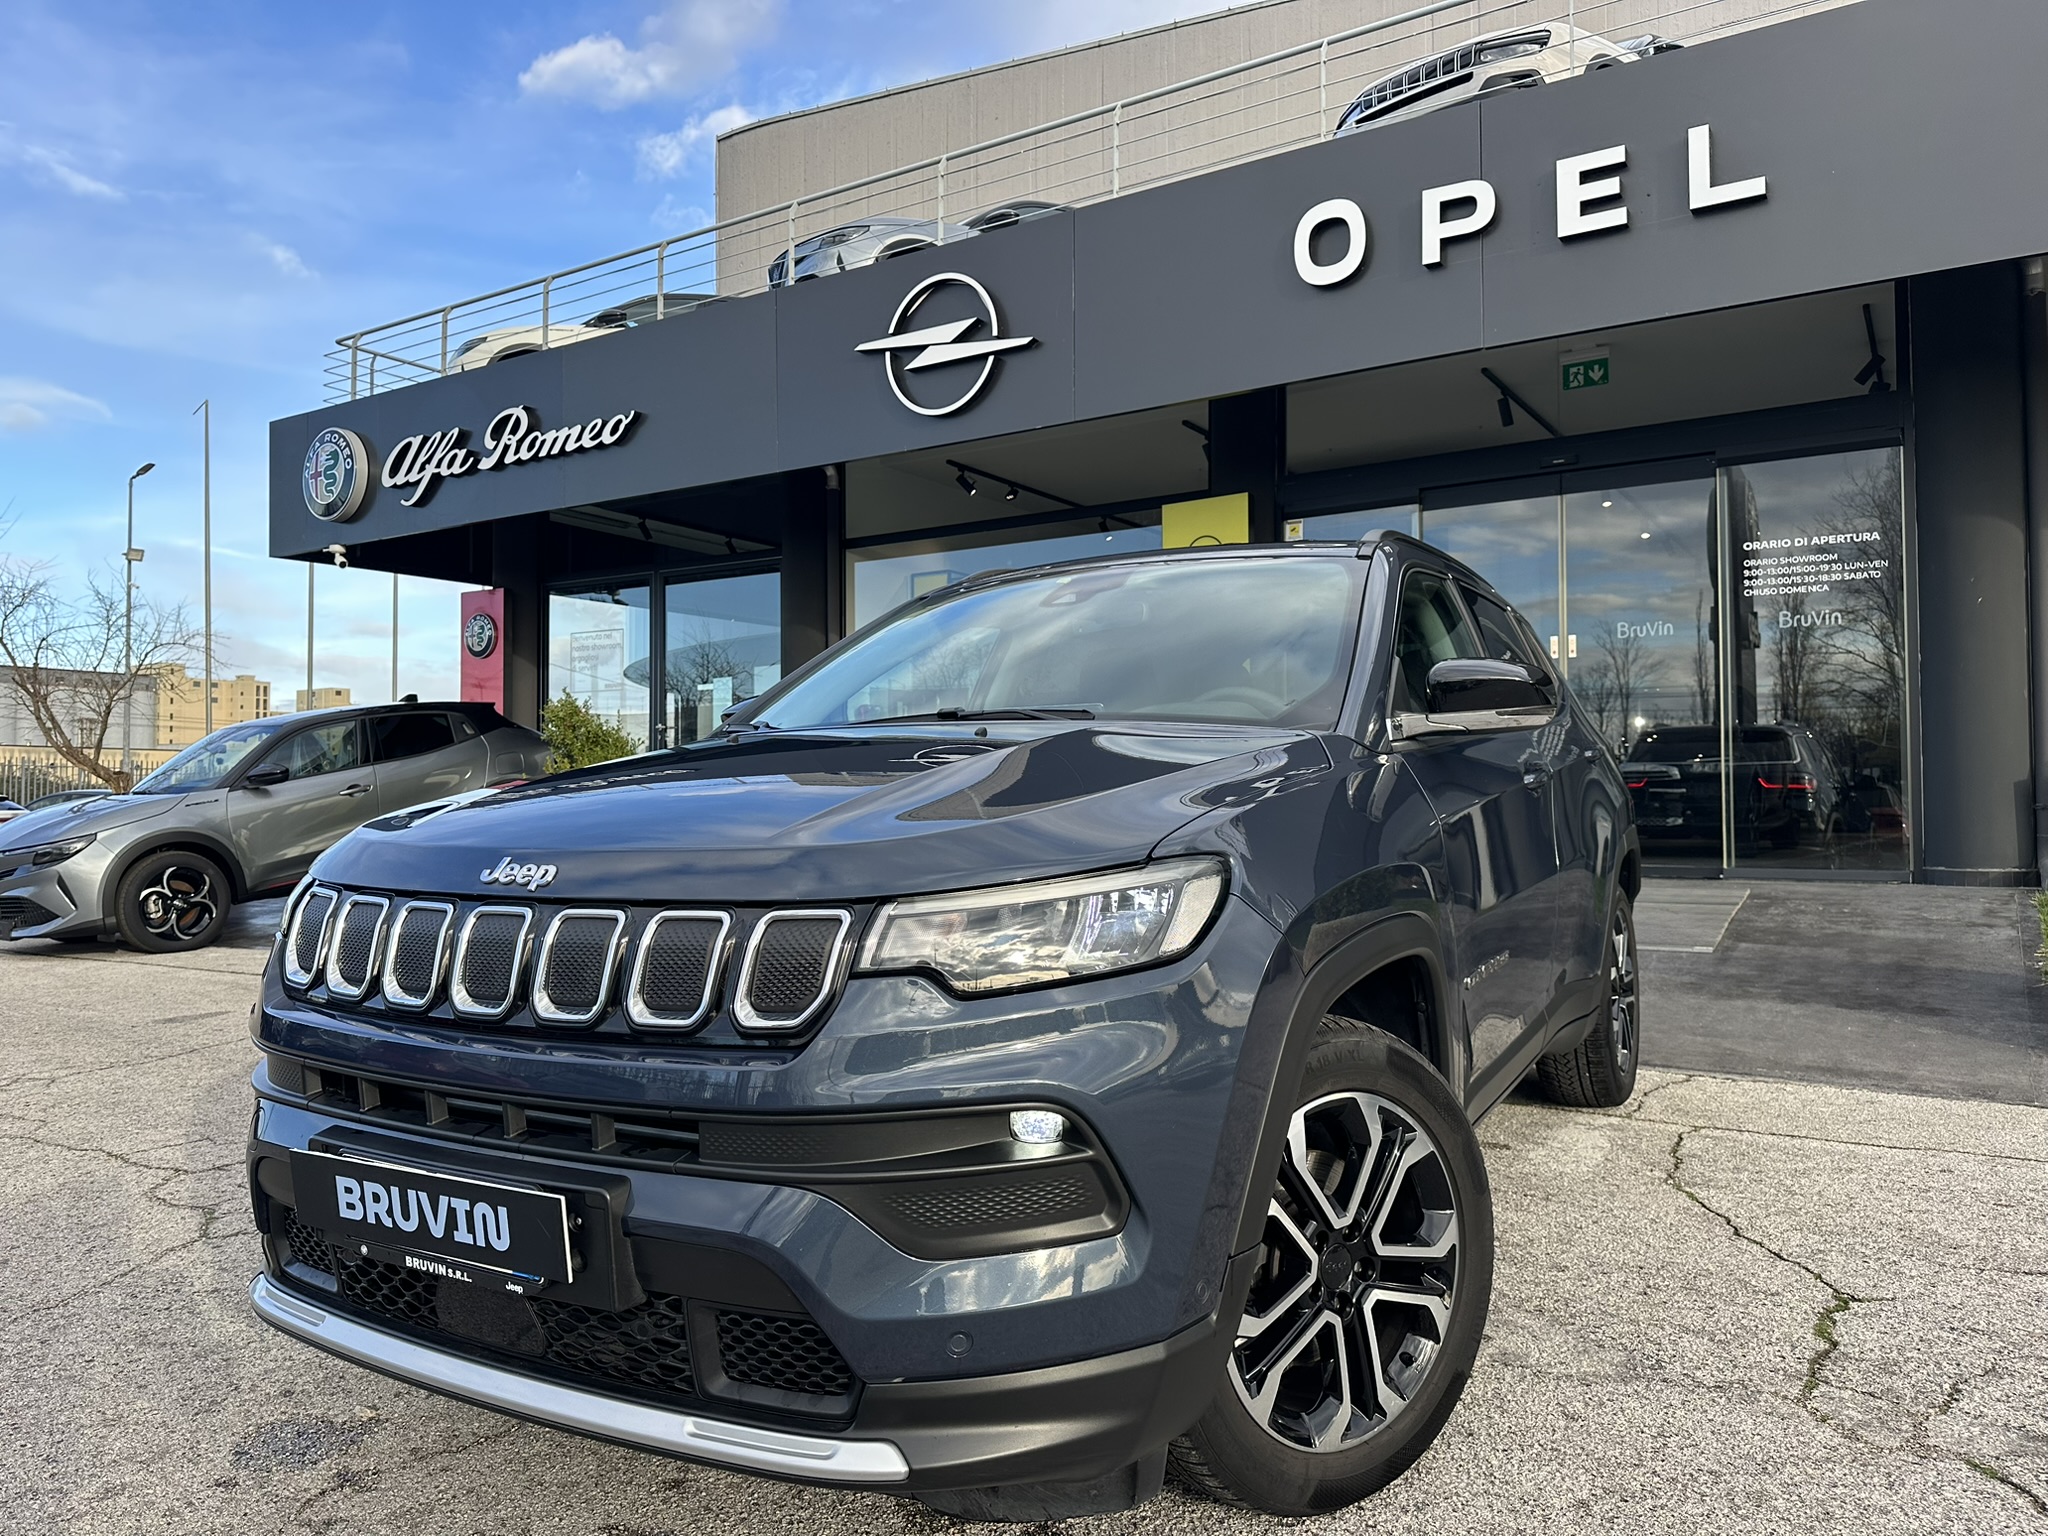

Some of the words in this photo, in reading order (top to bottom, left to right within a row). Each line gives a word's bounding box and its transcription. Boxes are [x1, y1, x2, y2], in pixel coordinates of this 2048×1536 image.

[1293, 123, 1768, 288] OPEL
[323, 433, 352, 470] ROMEO
[381, 426, 474, 507] Alfa
[477, 404, 635, 471] Romeo
[1743, 538, 1791, 551] ORARIO
[1794, 537, 1808, 547] DI
[1810, 531, 1881, 546] APERTURA
[1743, 557, 1778, 568] ORARIO
[1779, 553, 1838, 564] SHOWROOM
[1844, 559, 1889, 570] LUN-VEN
[1843, 570, 1882, 581] SABATO
[1743, 587, 1778, 598] CHIUSO
[1779, 583, 1830, 596] DOMENICA
[1778, 609, 1843, 629] BruVin
[1616, 620, 1674, 639] BruVin
[480, 856, 558, 892] Jeep
[334, 1174, 511, 1251] BRUVIN
[405, 1255, 447, 1276] BRUVIN
[447, 1268, 473, 1283] S.R.L.
[505, 1281, 524, 1295] Jeep
